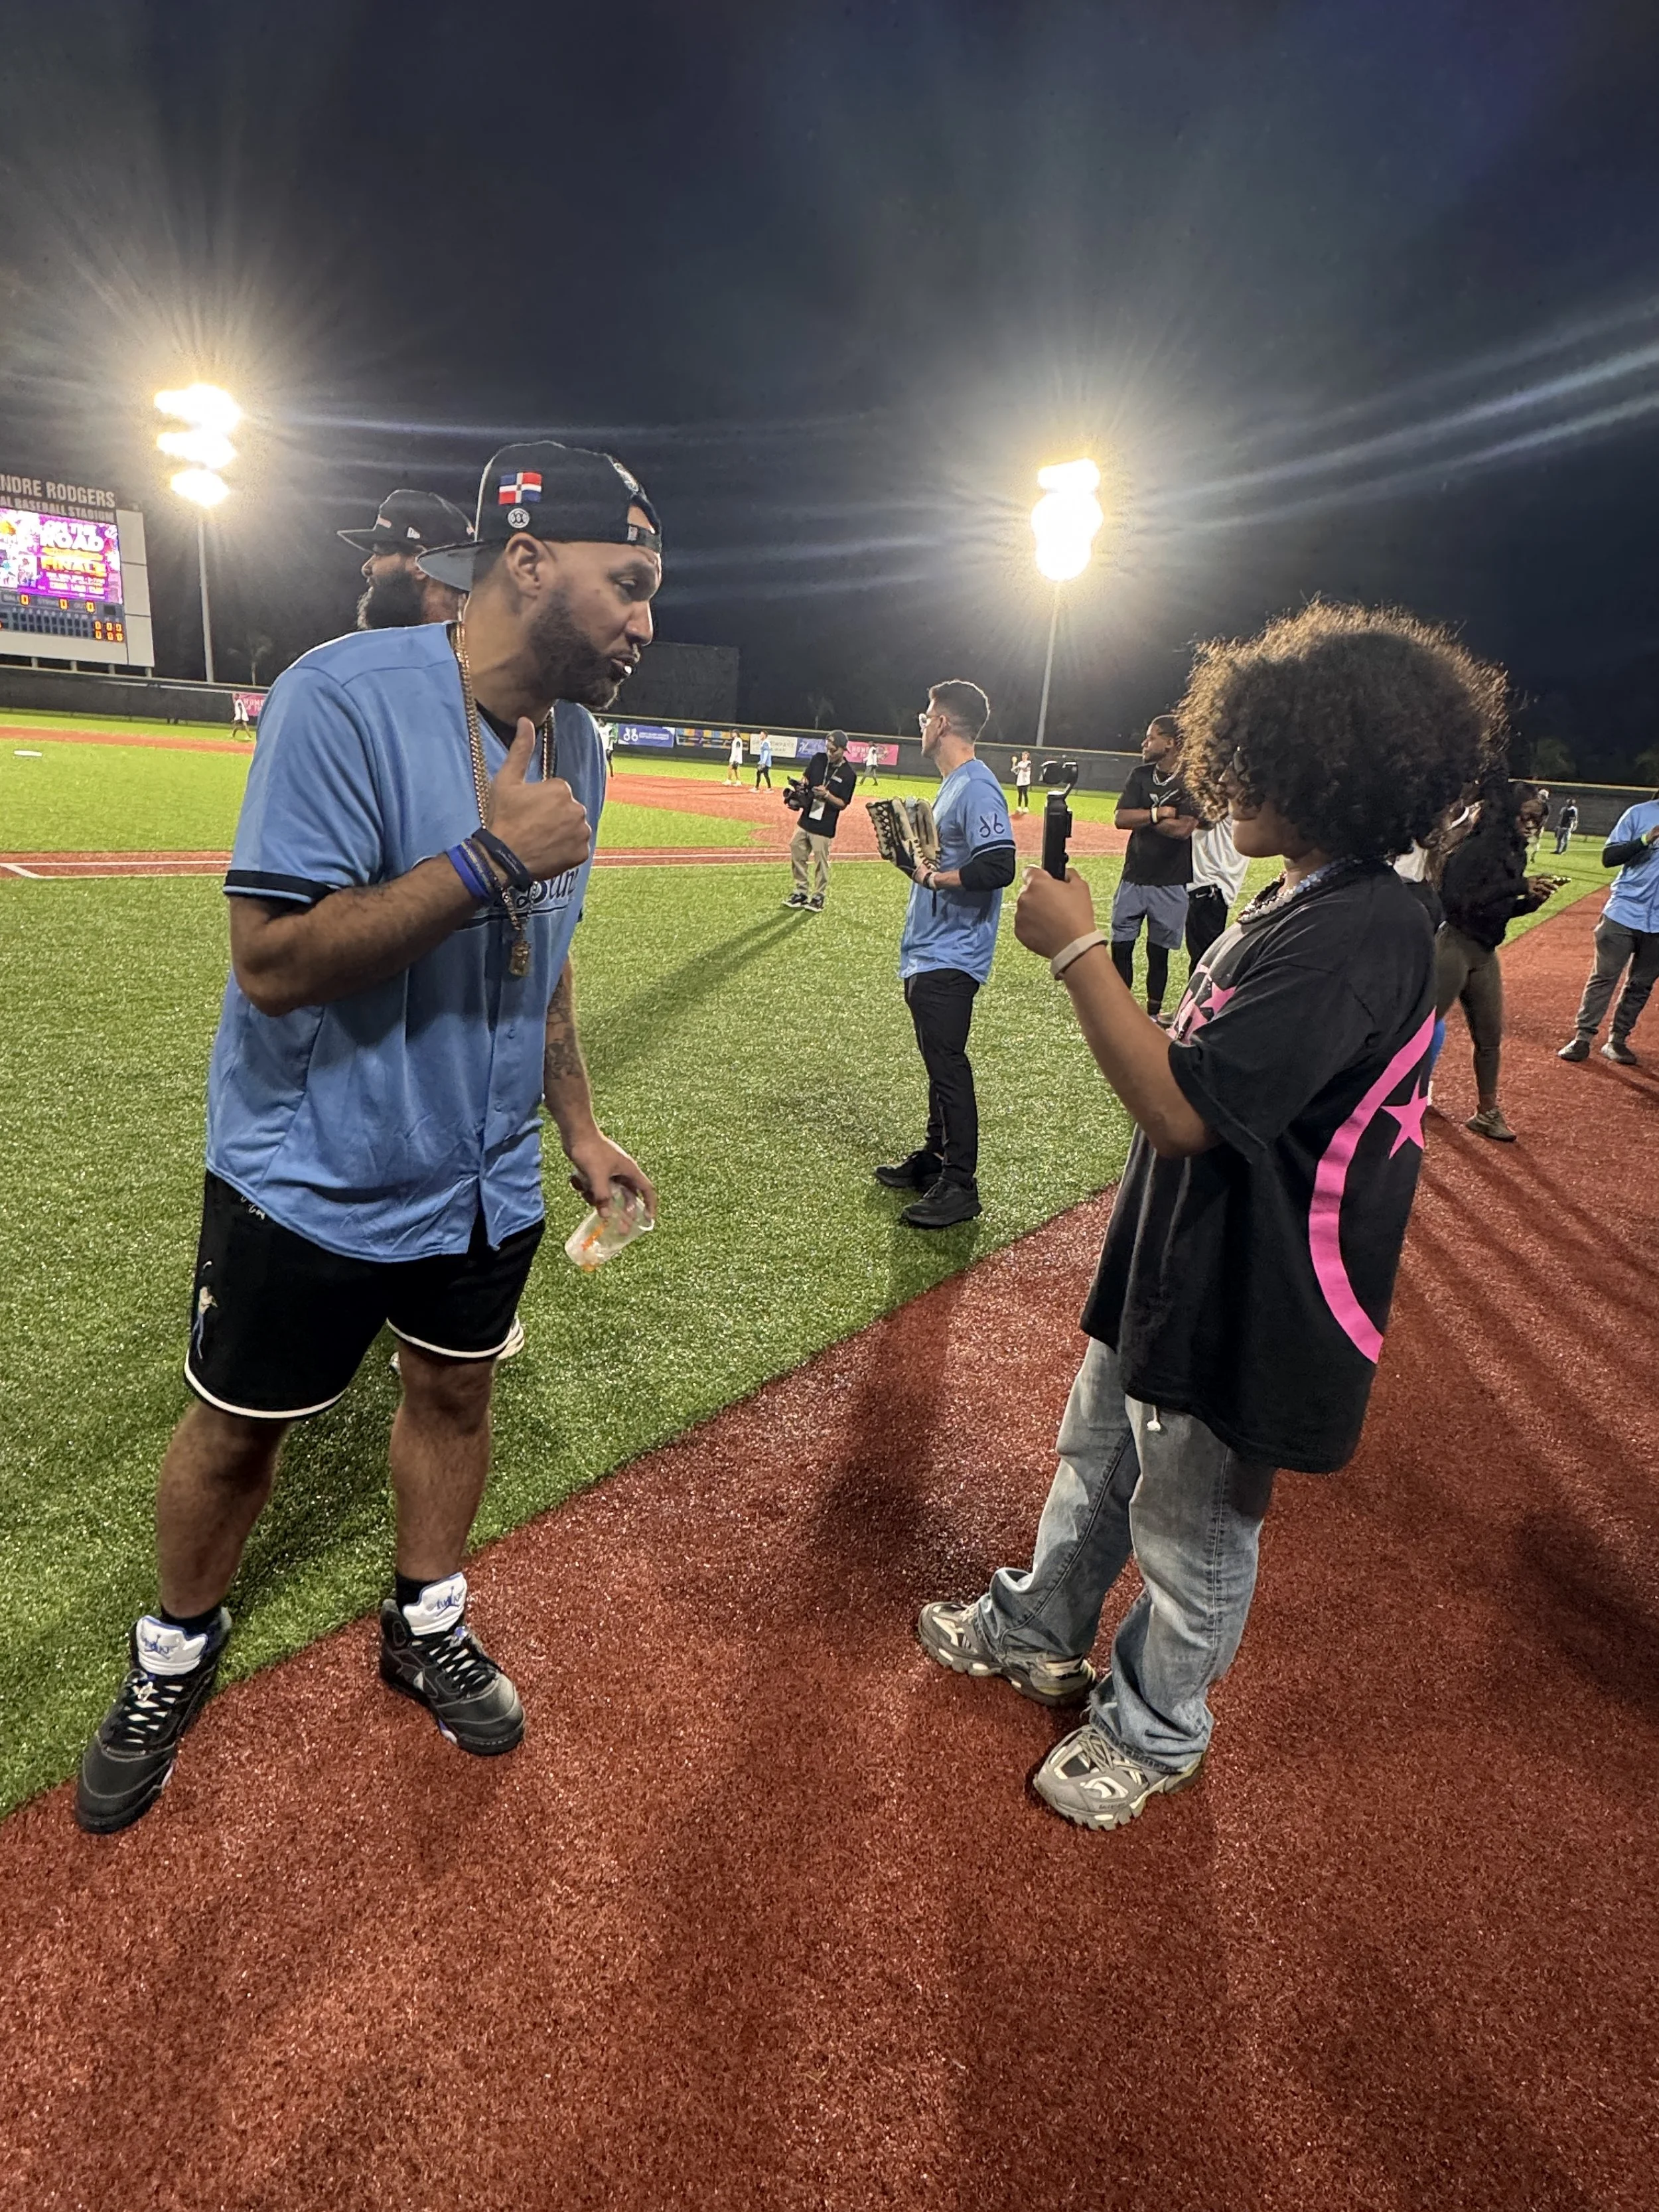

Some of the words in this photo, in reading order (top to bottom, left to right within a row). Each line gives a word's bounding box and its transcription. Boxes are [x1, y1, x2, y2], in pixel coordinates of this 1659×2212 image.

[0, 475, 42, 497] NDRE
[46, 481, 115, 508] RODGERS
[15, 498, 66, 517] BASEBALL
